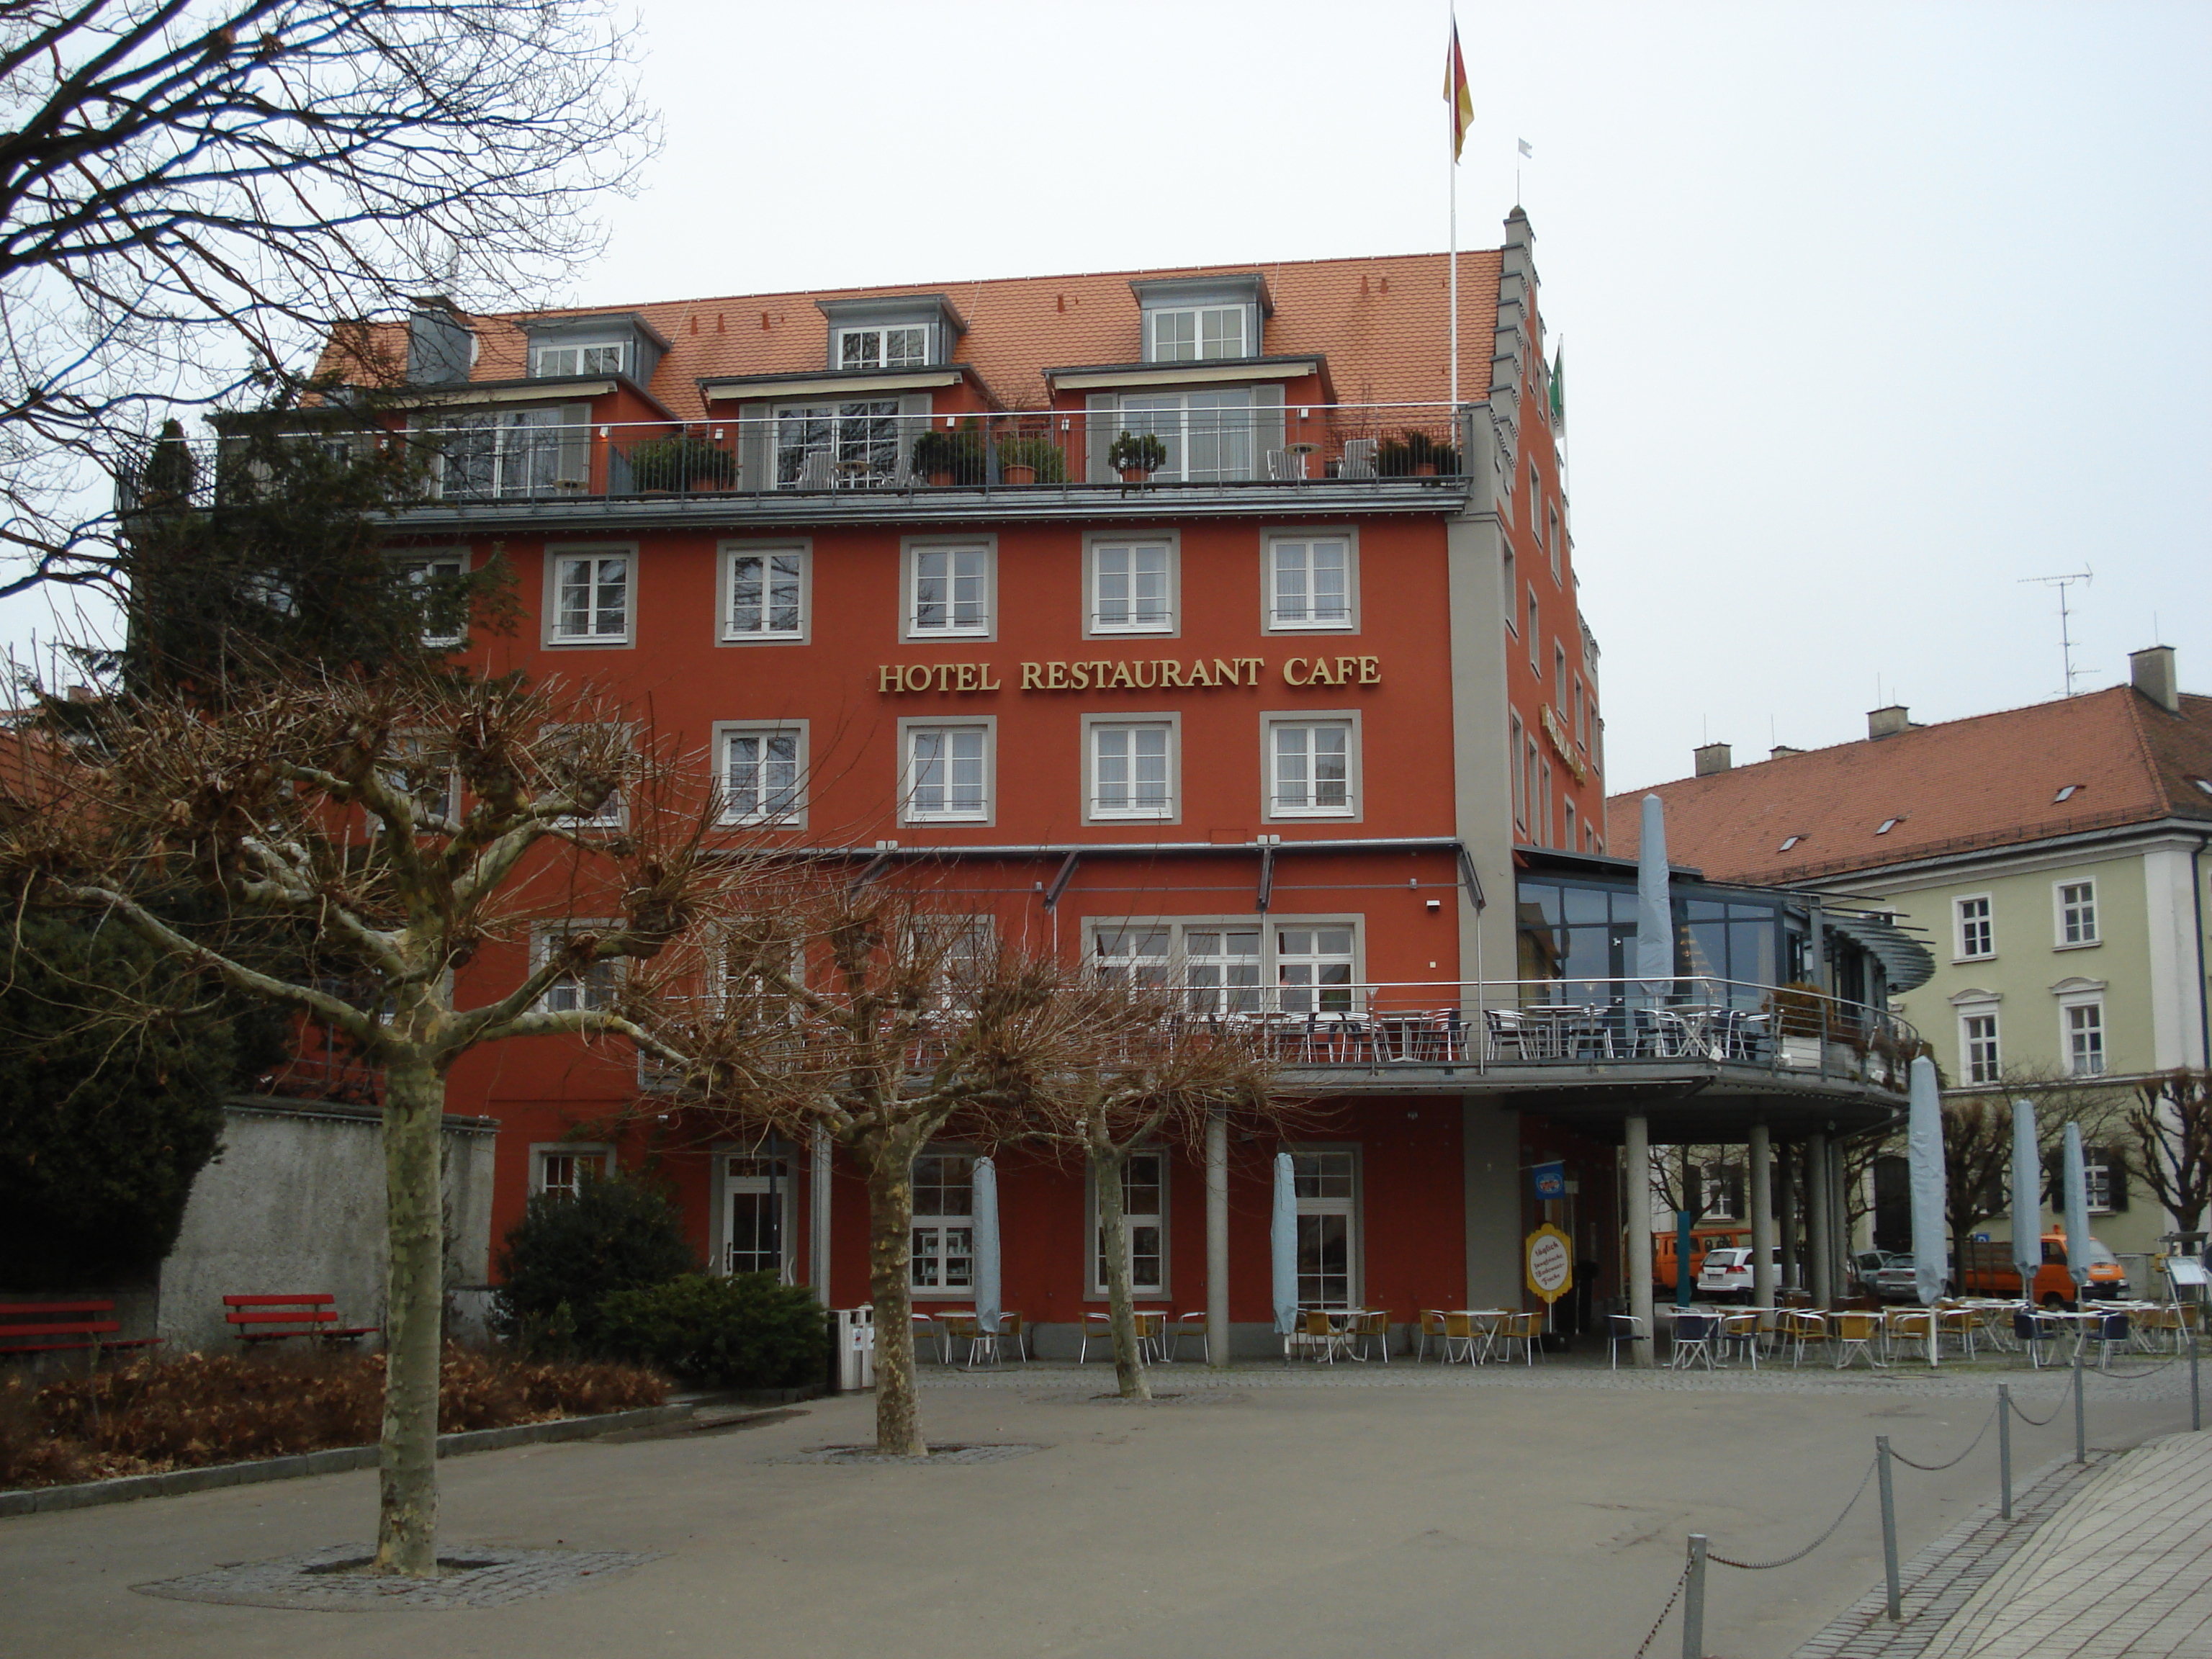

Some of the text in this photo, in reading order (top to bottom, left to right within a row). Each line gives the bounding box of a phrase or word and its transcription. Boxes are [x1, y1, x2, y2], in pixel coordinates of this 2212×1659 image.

[878, 656, 1382, 693] HOTEL RESTAURANT CAFE
